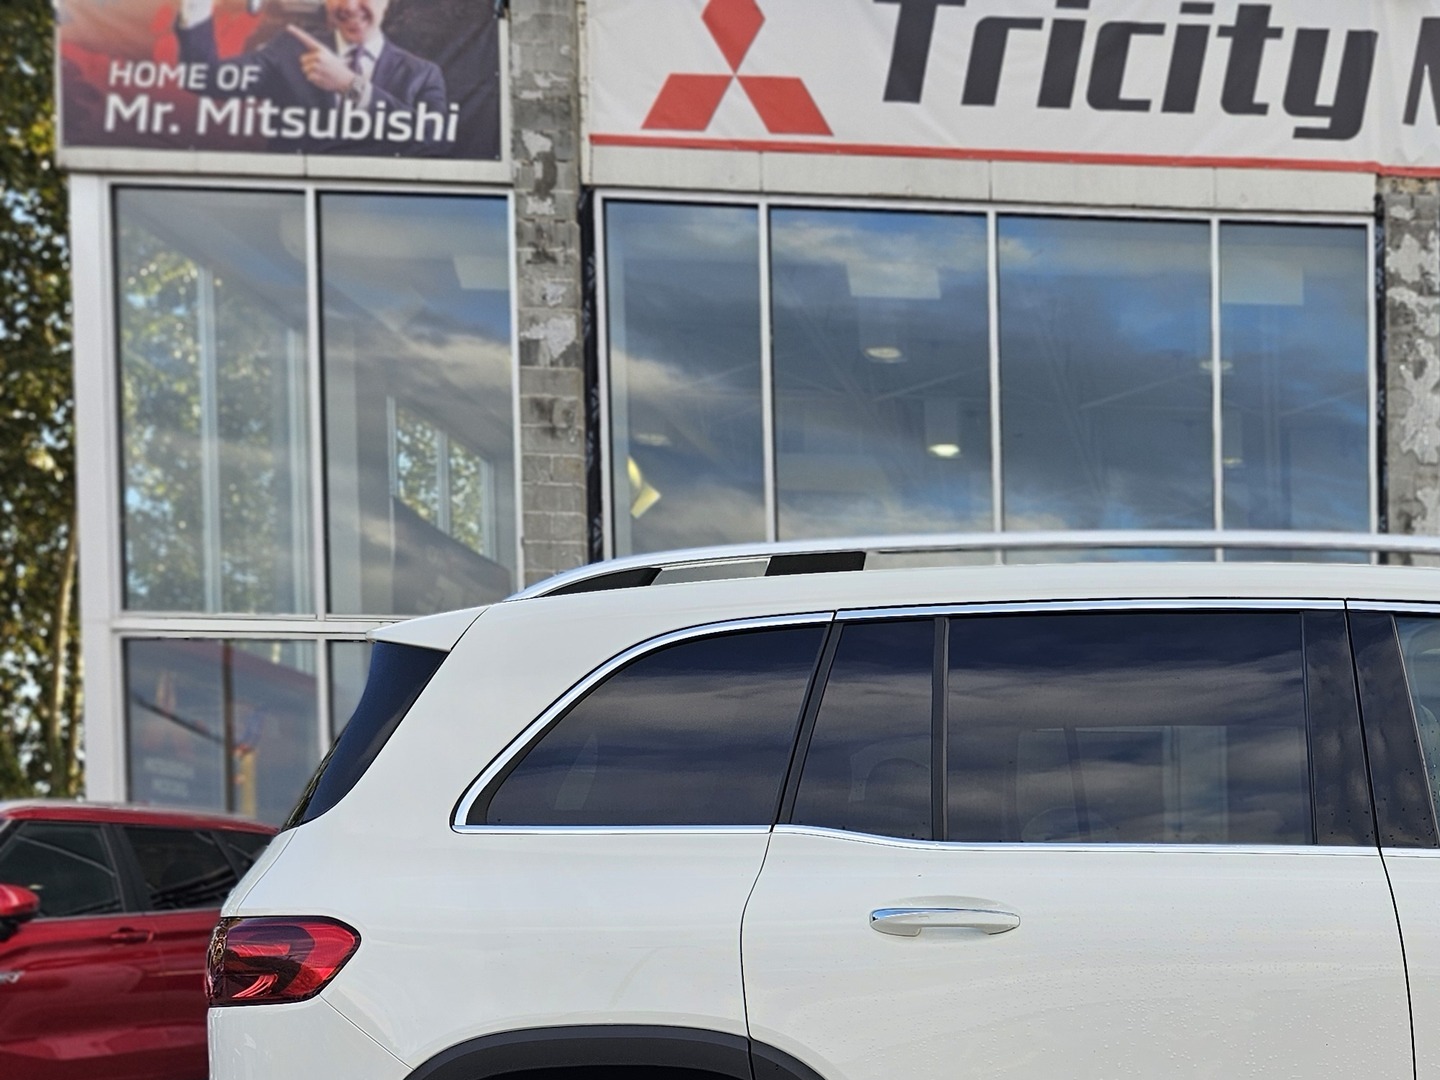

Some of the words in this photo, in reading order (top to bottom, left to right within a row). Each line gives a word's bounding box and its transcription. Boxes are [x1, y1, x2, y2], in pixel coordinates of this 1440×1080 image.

[108, 60, 208, 89] HOME
[216, 64, 262, 91] OF
[873, 0, 1379, 141] Tricity
[103, 94, 180, 135] Mr.
[199, 98, 460, 142] Mitsubishi
